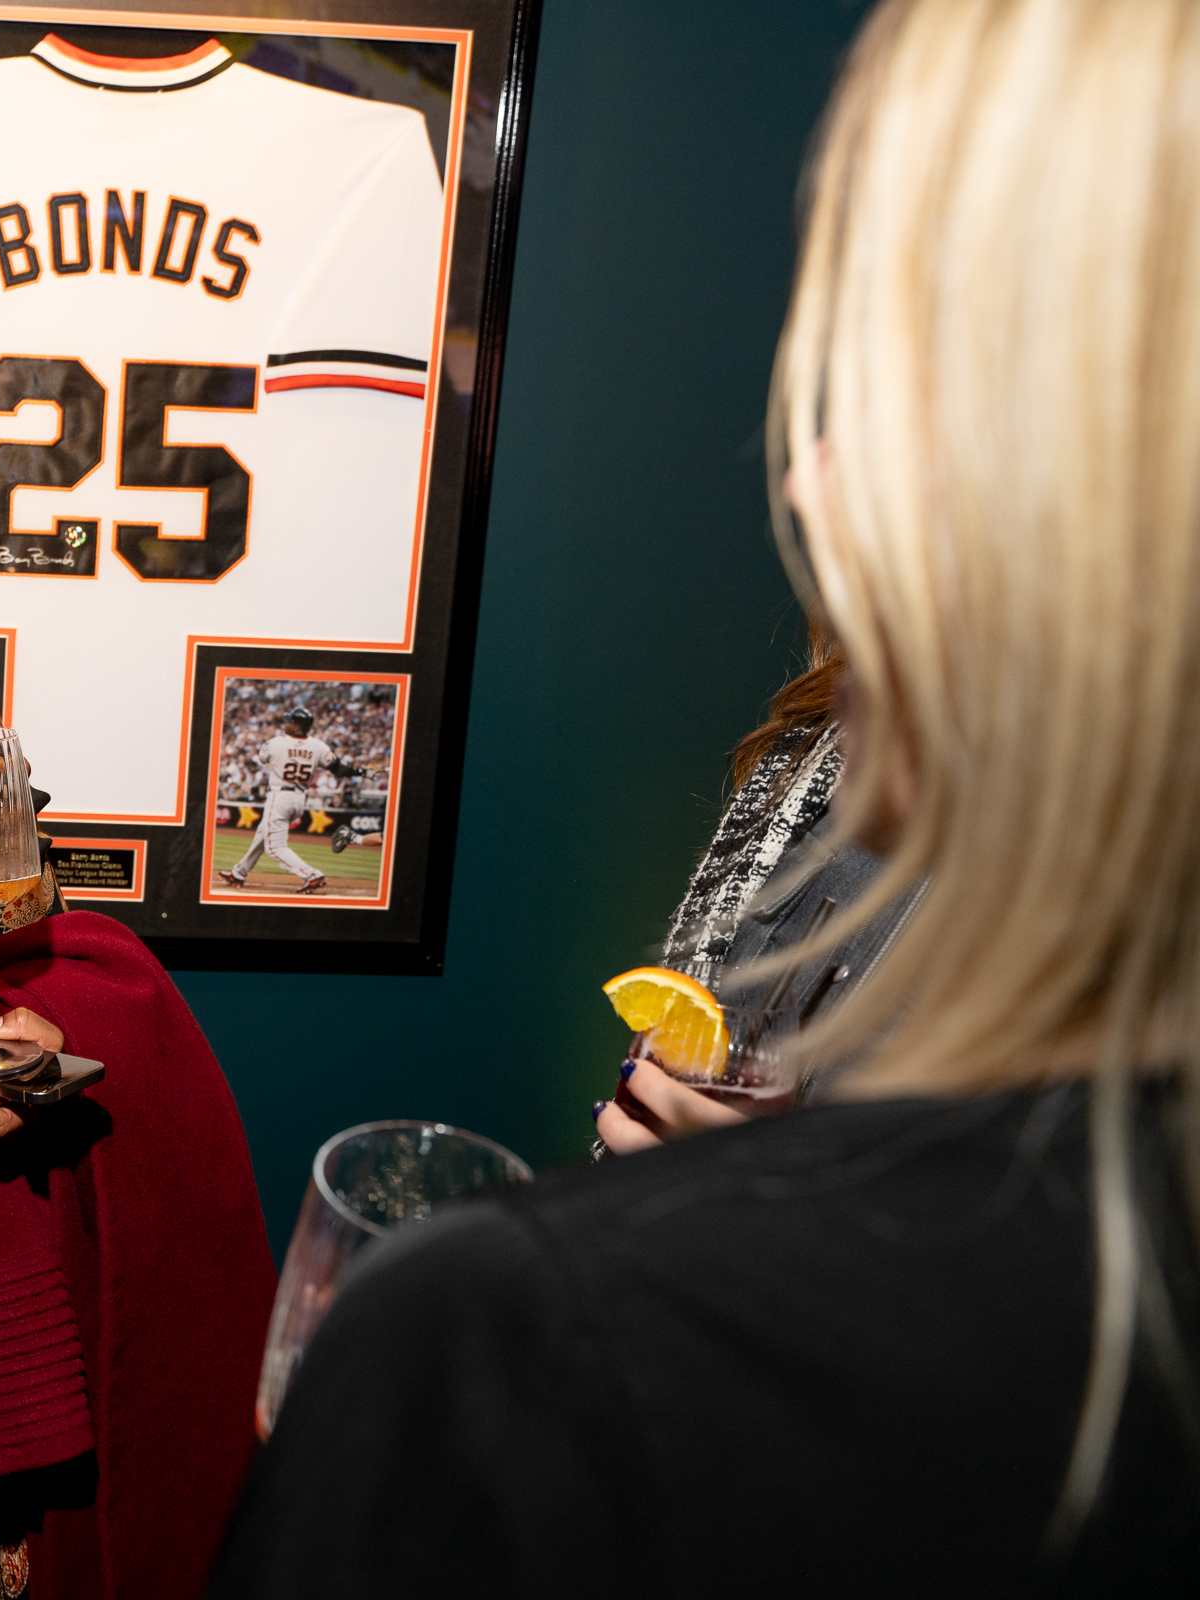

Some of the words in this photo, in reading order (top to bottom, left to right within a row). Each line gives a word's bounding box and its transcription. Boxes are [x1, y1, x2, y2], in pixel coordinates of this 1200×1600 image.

[287, 749, 313, 760] BONDS
[283, 762, 312, 783] 25
[350, 815, 382, 831] COX
